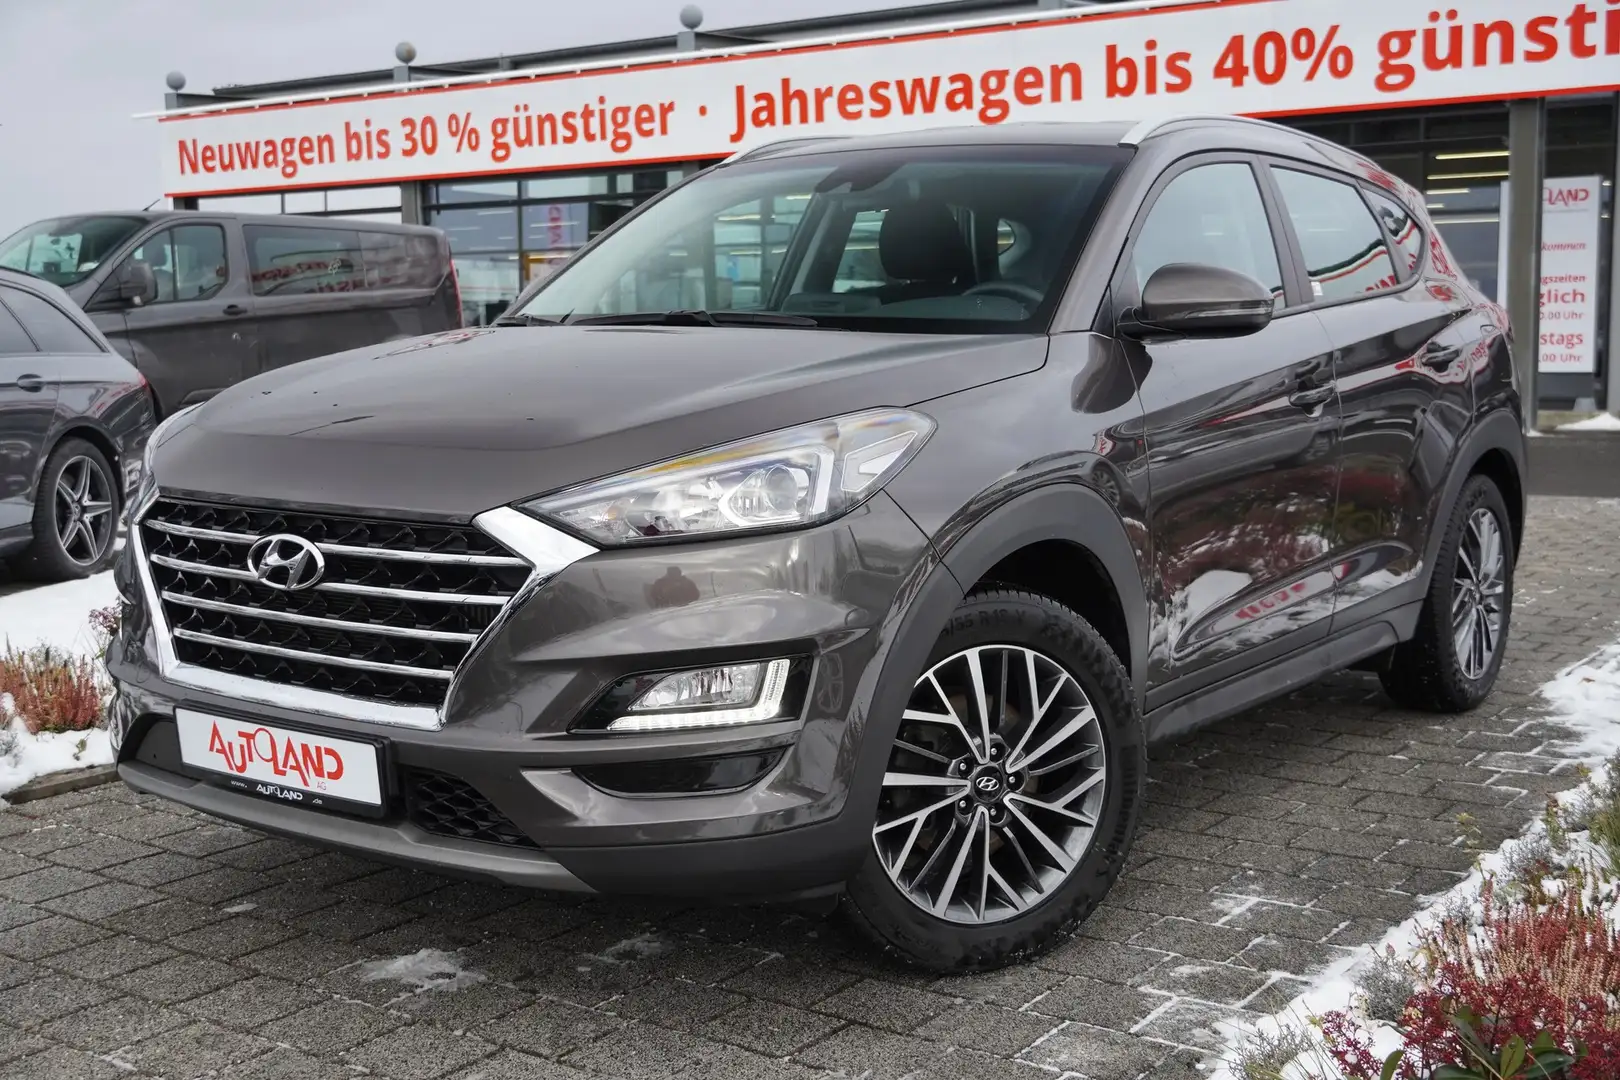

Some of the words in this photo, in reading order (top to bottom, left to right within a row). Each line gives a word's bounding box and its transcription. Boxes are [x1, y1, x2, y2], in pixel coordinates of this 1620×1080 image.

[178, 134, 336, 179] Neuwagen
[345, 119, 391, 161] bis
[401, 115, 439, 158] 30
[447, 112, 480, 153] %
[490, 95, 676, 153] günstiger
[730, 63, 1083, 143] Jahreswagen
[1105, 38, 1193, 99] bis
[1211, 23, 1355, 88] 40%
[1374, 0, 1620, 94] günsti
[1541, 242, 1587, 251] kommen
[1540, 273, 1587, 286] gszeiten
[1539, 288, 1587, 308] glich
[1539, 332, 1584, 350] stags
[208, 719, 344, 788] AUTOLAND
[256, 783, 303, 801] AUTOLAND
